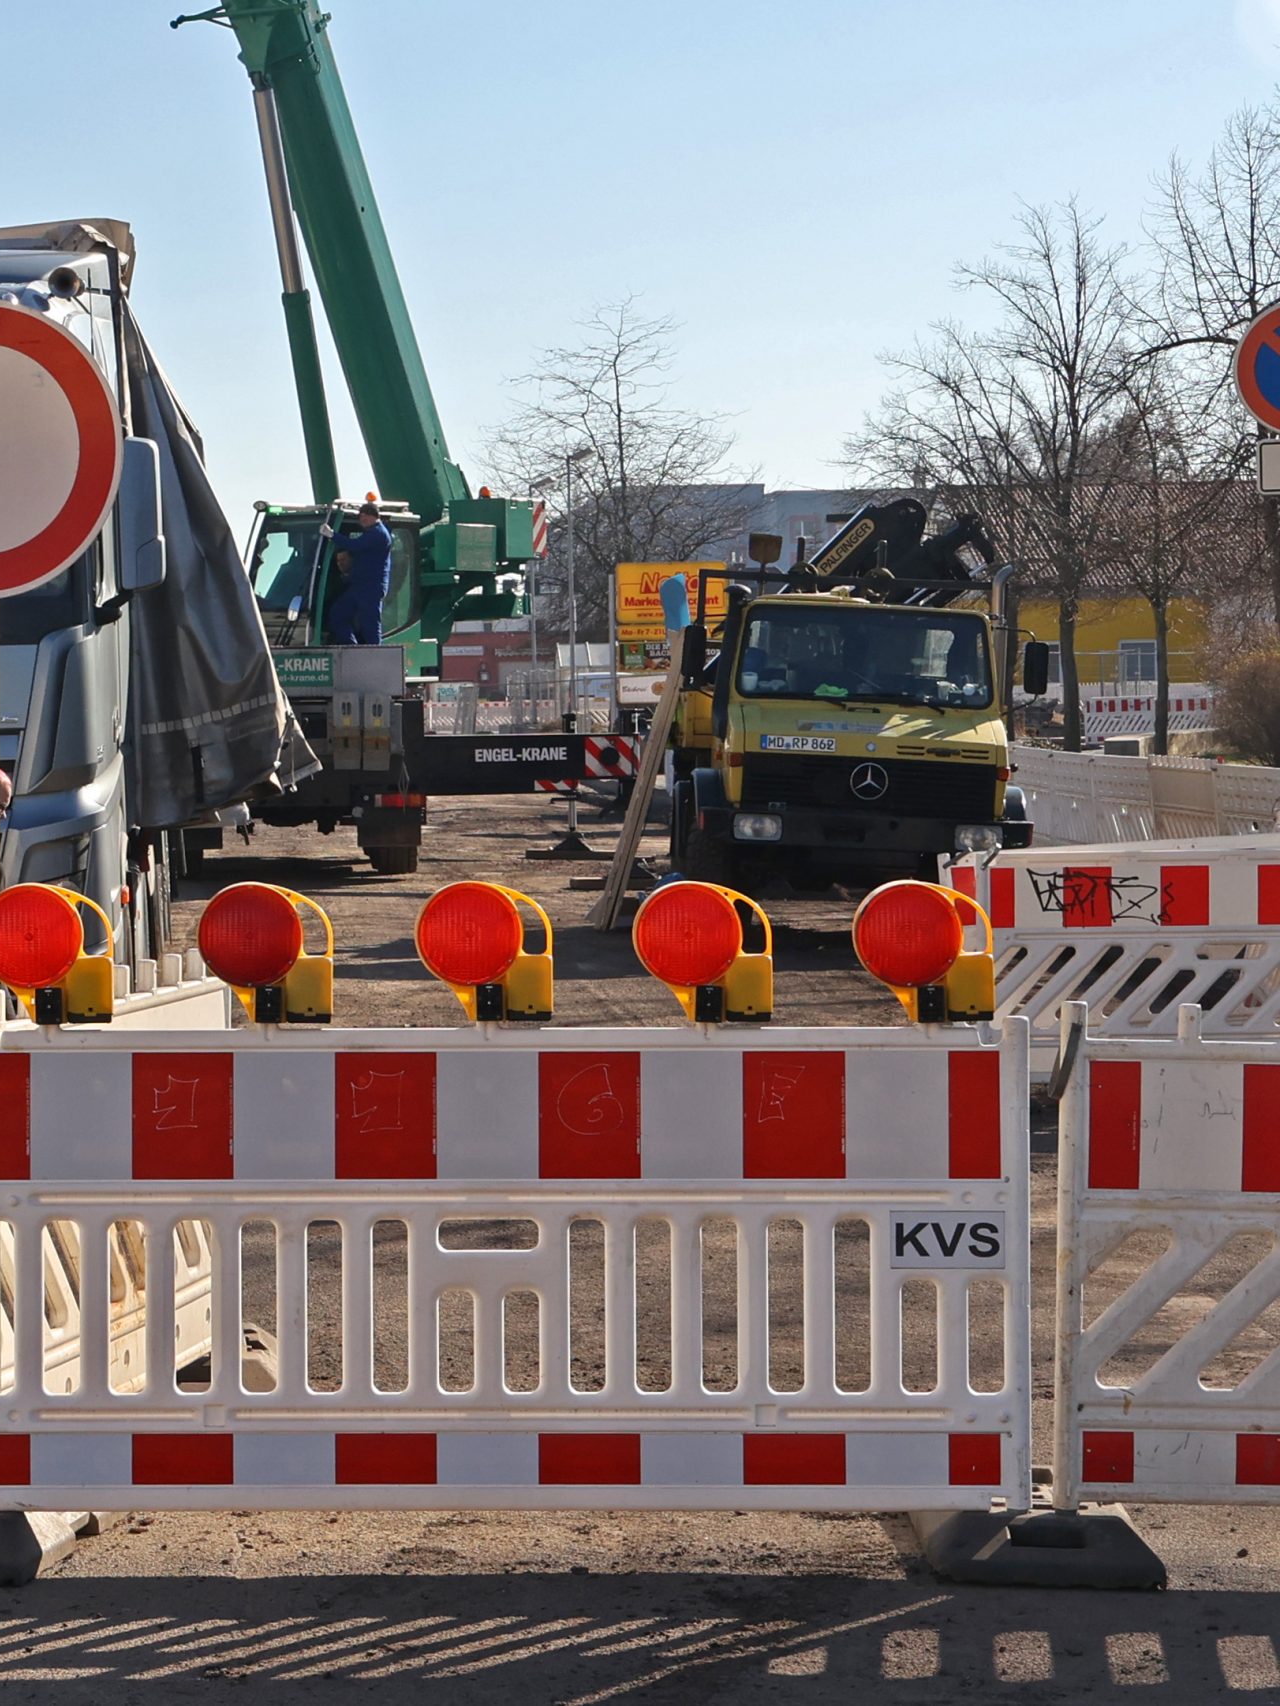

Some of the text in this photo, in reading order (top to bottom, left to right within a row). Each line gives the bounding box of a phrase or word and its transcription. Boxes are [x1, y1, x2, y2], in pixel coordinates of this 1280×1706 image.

[820, 522, 872, 573] PALFINGER
[474, 746, 568, 762] ENGEL-KRANE
[768, 736, 834, 751] MD RP 862
[895, 1222, 1001, 1258] KVS
